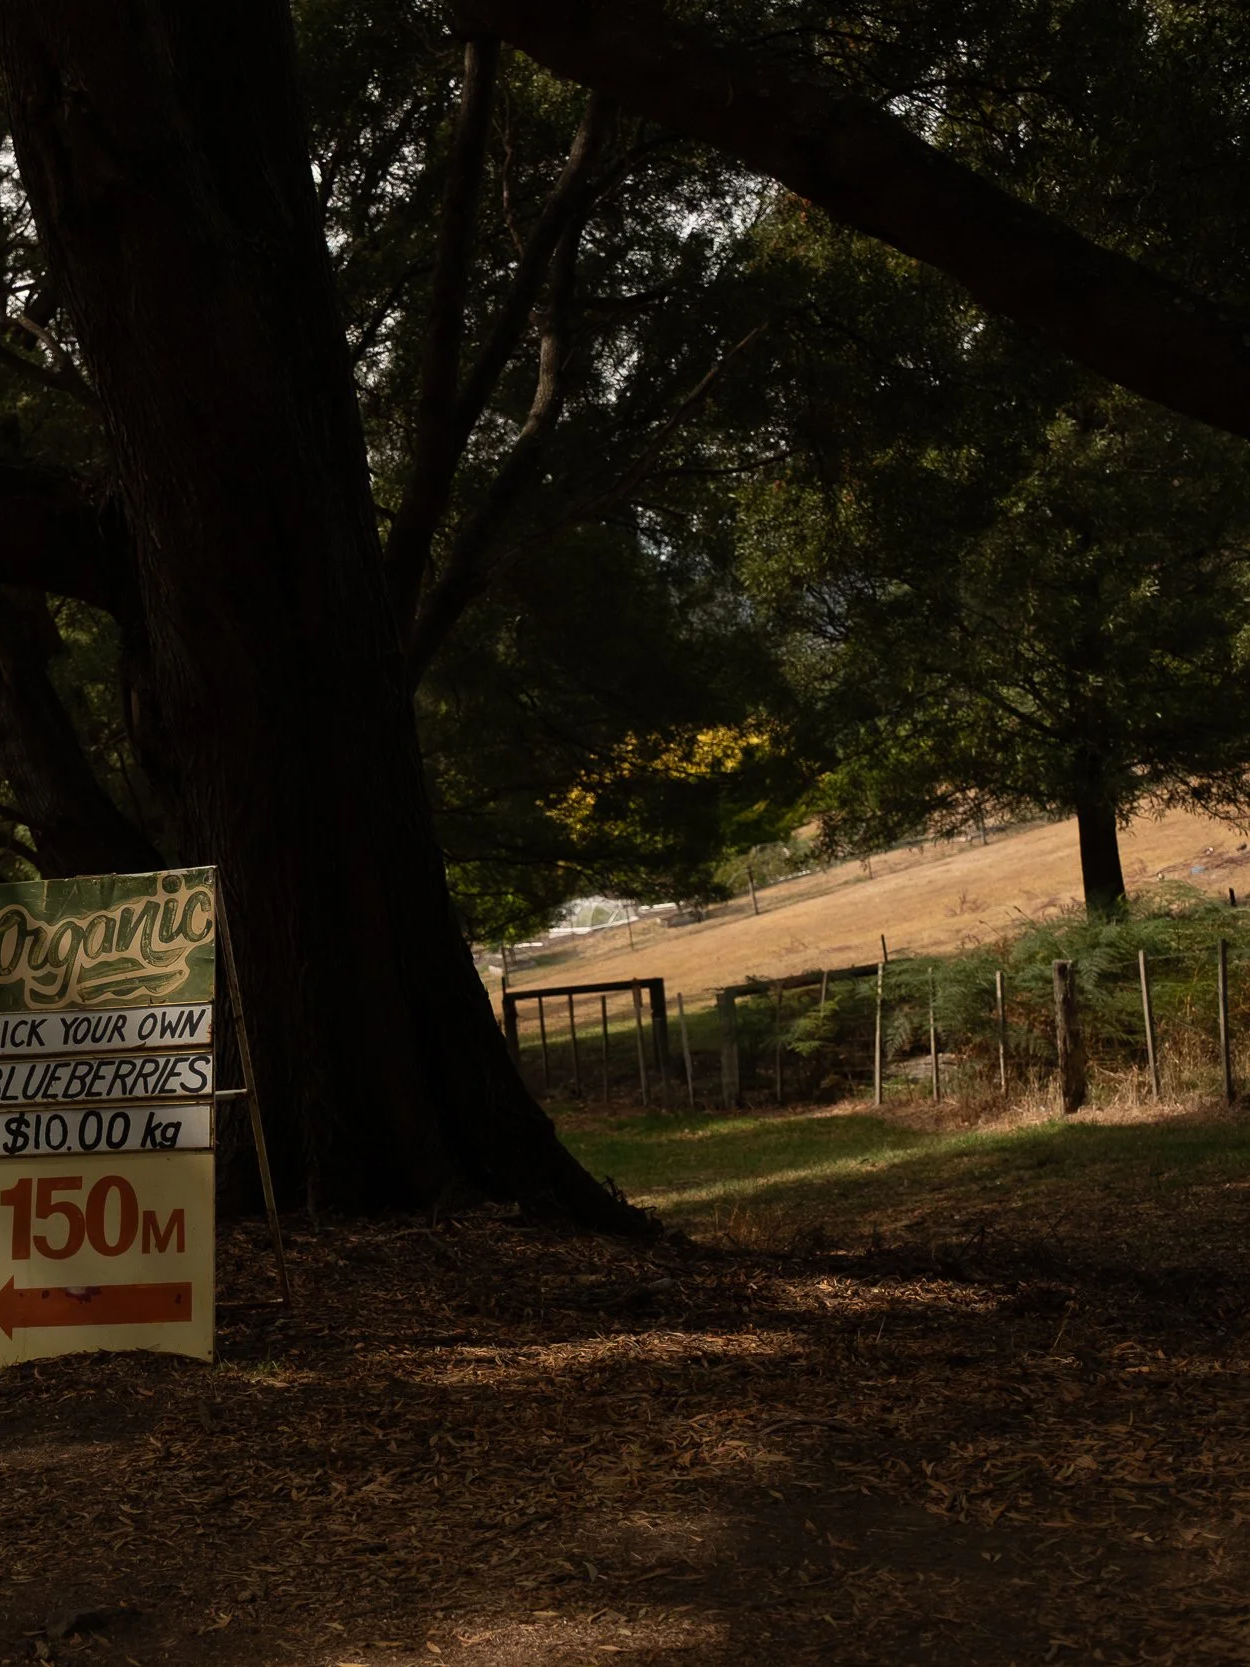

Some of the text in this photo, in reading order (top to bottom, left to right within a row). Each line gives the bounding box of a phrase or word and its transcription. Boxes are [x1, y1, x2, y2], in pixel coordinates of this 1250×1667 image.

[60, 1013, 128, 1045] YOUR
[137, 1008, 207, 1041] OWN
[2, 1110, 182, 1155] $10.00 kg
